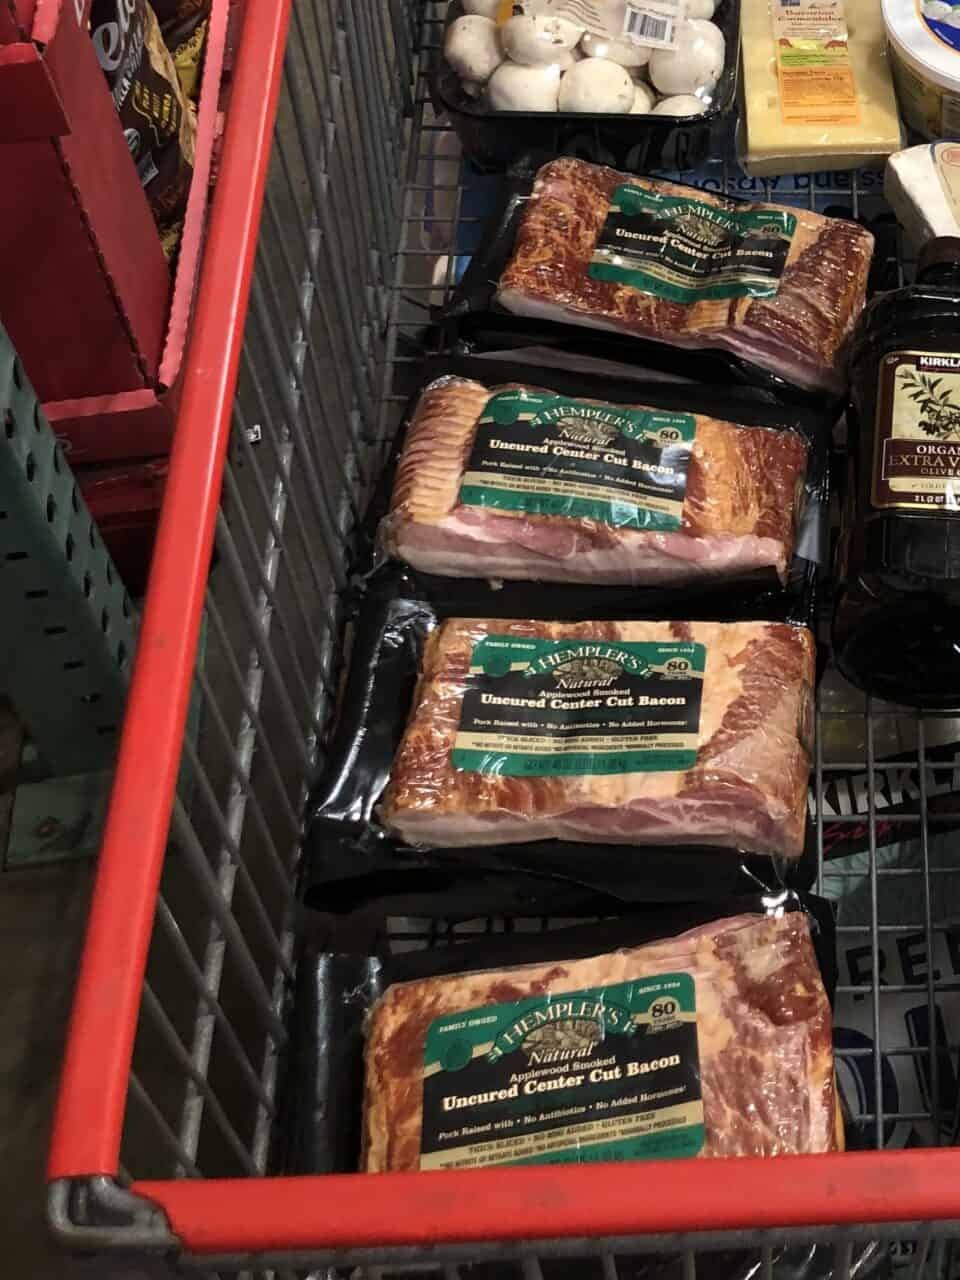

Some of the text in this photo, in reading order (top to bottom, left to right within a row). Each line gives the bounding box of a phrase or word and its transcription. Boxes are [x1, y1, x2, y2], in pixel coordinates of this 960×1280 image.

[616, 228, 668, 244] Uncured
[559, 429, 614, 446] Natural
[659, 430, 680, 442] 80
[489, 439, 675, 474] Uncured Center Cut Bacon
[889, 456, 944, 466] EXTRA
[539, 646, 641, 669] HEMPLER'S
[666, 661, 688, 671] 80
[556, 677, 612, 690] Natural
[481, 694, 686, 710] Uncured Center Cut Bacon
[651, 1001, 676, 1018] 80
[503, 1001, 623, 1046] HEMPLER'S
[527, 1041, 595, 1066] Natural
[510, 1056, 616, 1083] Applewood Smoked
[443, 1053, 681, 1112] Uncured Center Cut Bacon
[438, 1130, 460, 1141] Pork
[462, 1122, 491, 1136] Raised
[494, 1119, 514, 1129] with
[524, 1115, 537, 1125] No
[595, 1101, 609, 1110] No
[611, 1095, 638, 1108] Added
